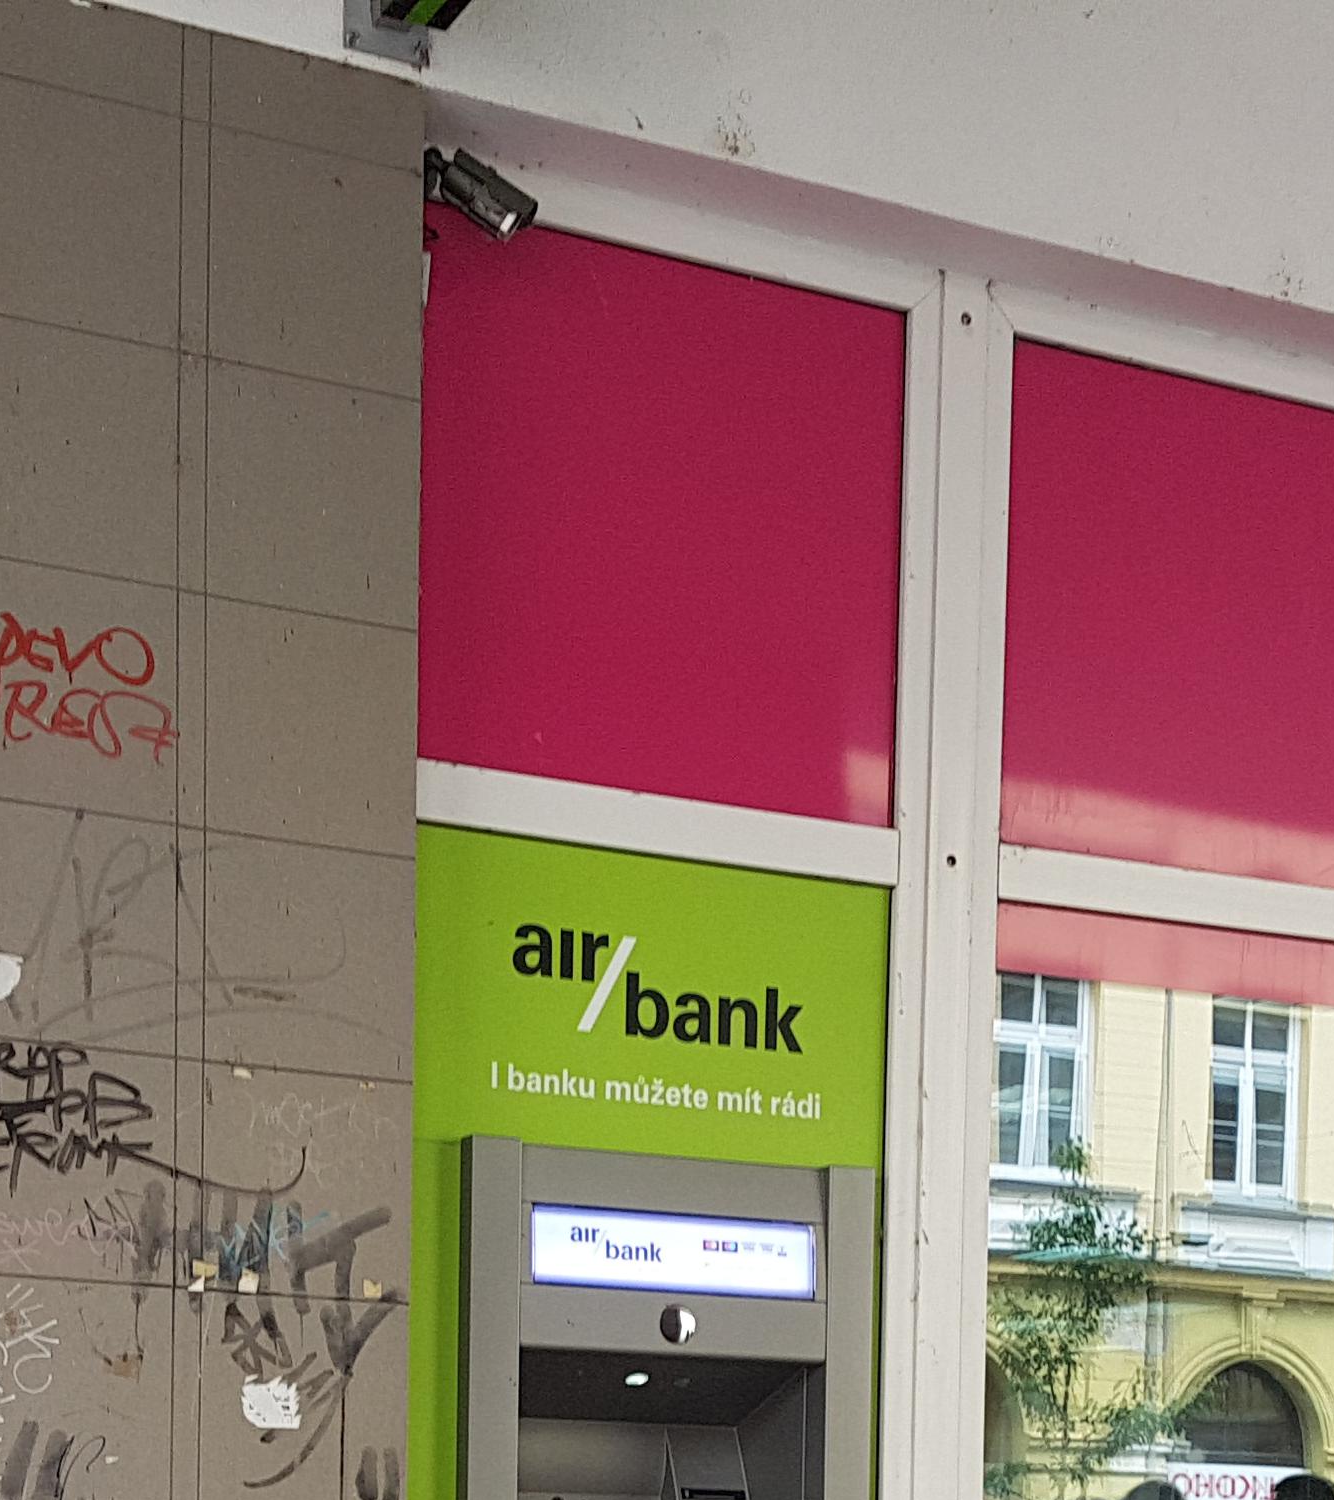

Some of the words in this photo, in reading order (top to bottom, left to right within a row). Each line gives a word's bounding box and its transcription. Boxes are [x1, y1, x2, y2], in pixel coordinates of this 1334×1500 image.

[624, 970, 804, 1054] bank
[490, 1061, 498, 1089] I
[507, 1063, 596, 1100] banku
[604, 1074, 709, 1111] můžete
[717, 1086, 763, 1115] mít
[770, 1089, 822, 1120] rádi
[605, 1237, 662, 1263] bank
